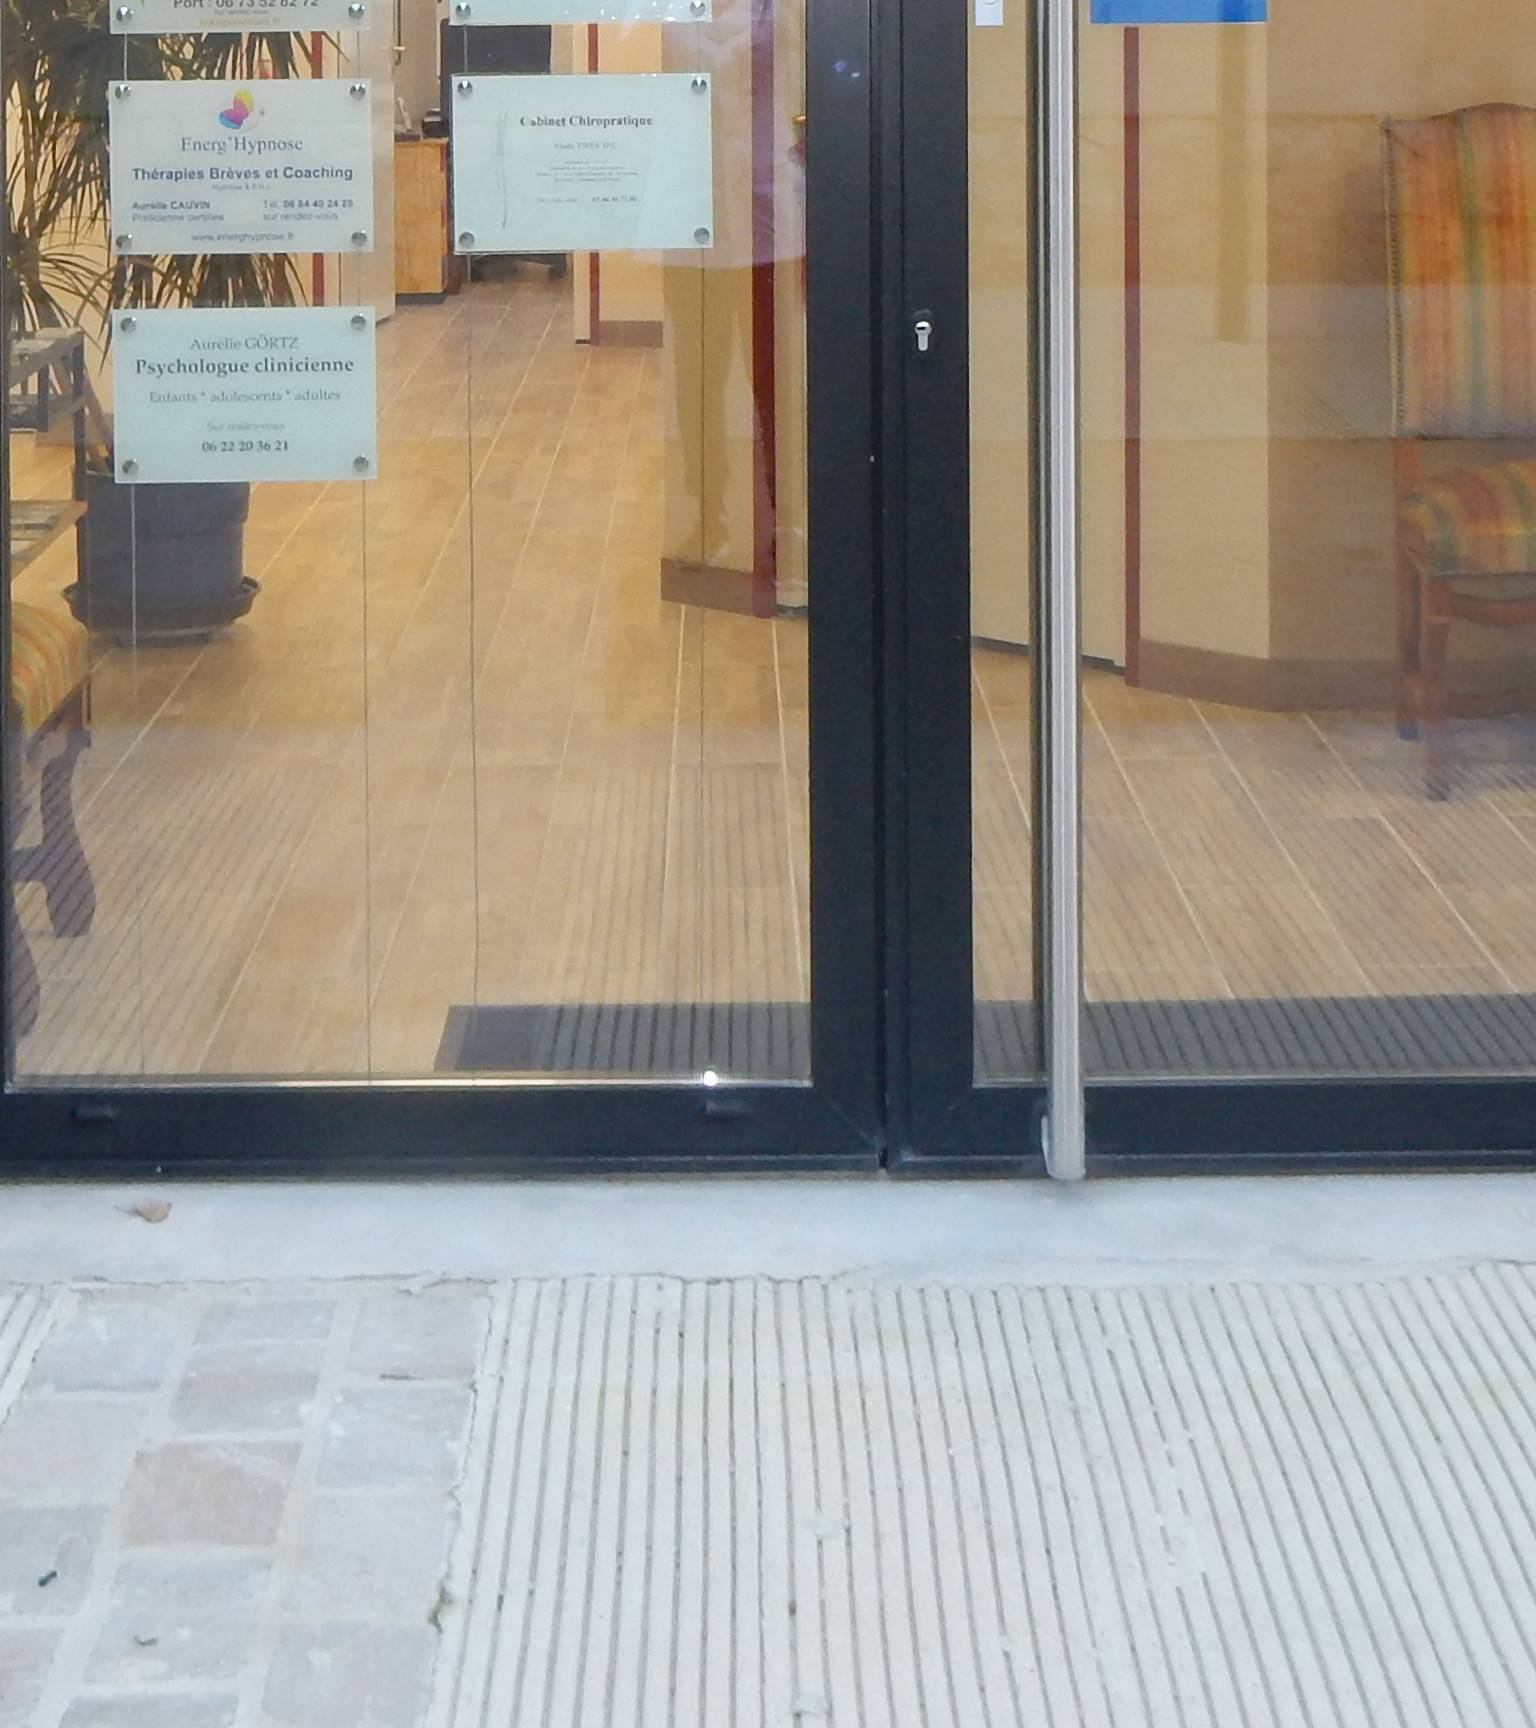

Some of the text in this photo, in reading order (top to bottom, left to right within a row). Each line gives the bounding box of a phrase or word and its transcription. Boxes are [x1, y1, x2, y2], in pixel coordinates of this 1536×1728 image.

[520, 115, 653, 129] Cabinet Chiropratique
[133, 166, 353, 182] Thérapies Brèves et Coaching
[190, 334, 299, 351] Aurélie GÖRTZ
[136, 357, 354, 378] Psychologue clinicienne
[149, 388, 341, 403] Enfants adolescents adultes
[202, 439, 289, 452] 06 22 20 36 21
